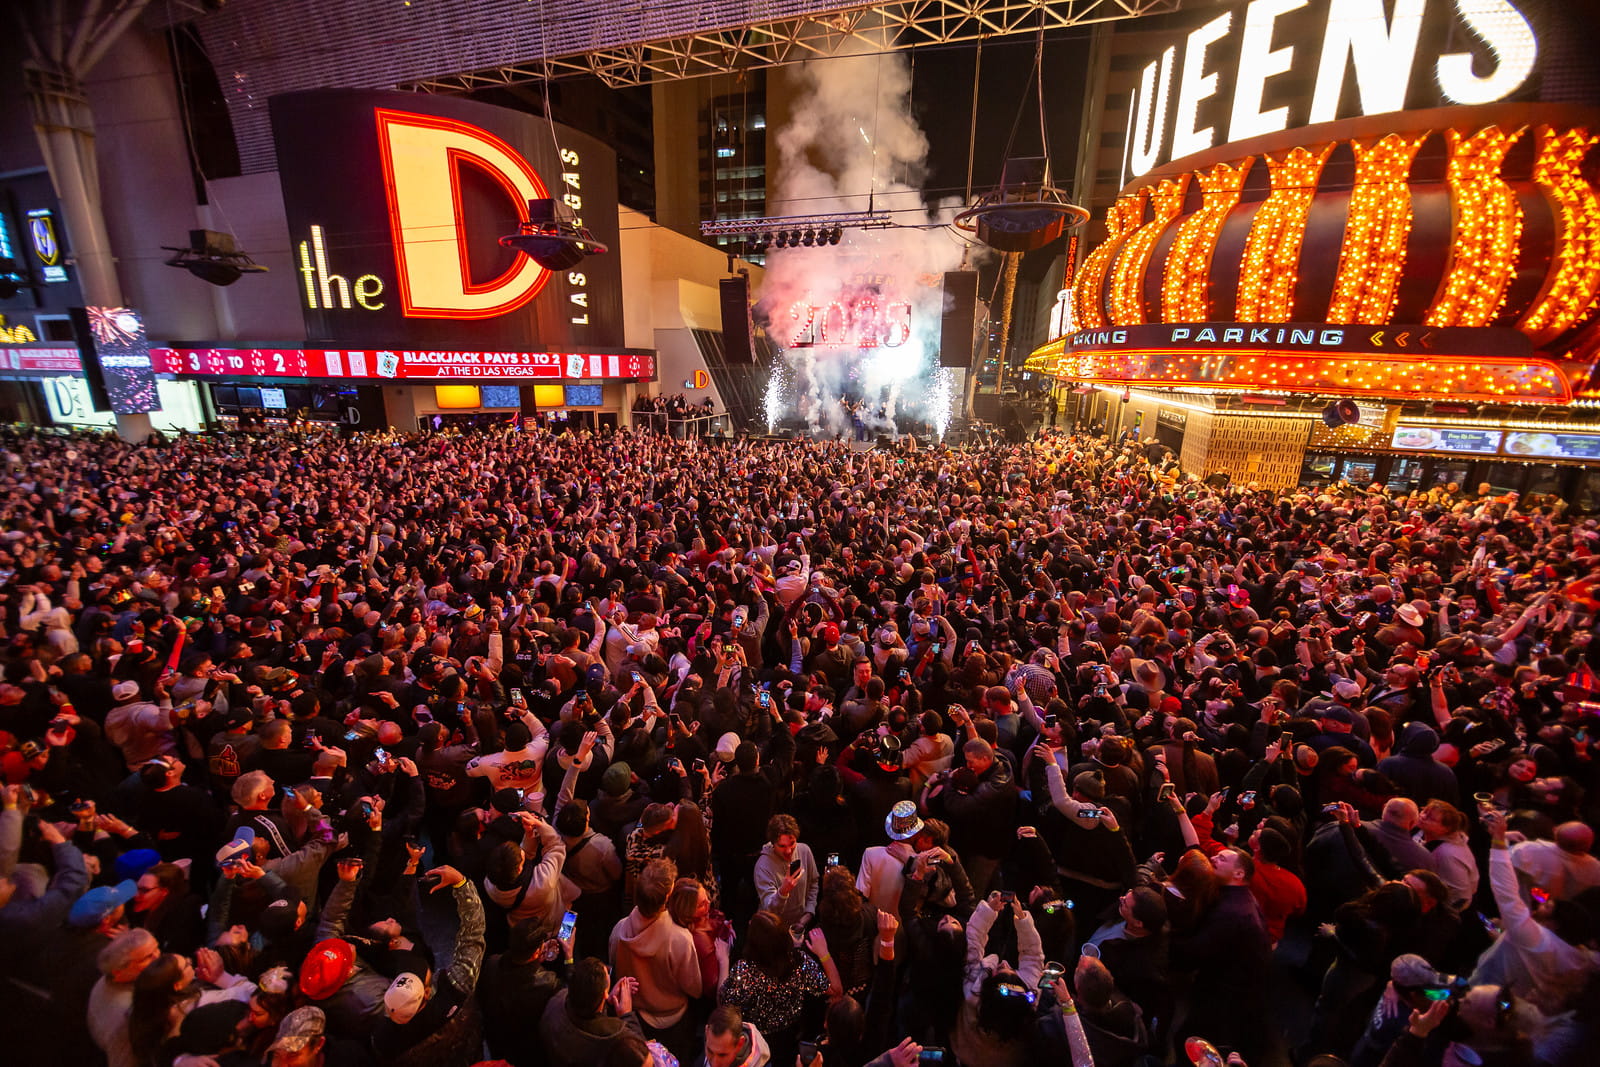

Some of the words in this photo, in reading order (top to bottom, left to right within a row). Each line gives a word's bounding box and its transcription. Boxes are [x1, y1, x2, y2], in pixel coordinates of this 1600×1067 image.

[1120, 0, 1538, 191] UEENS
[300, 225, 385, 311] the
[374, 107, 555, 320] D
[568, 271, 589, 326] LAS
[789, 300, 912, 348] 2025
[1171, 328, 1344, 346] PARKING
[188, 352, 201, 371] 3
[227, 355, 244, 369] TO
[272, 353, 286, 372] 2
[402, 351, 481, 364] BLACKJACK
[483, 352, 519, 364] PAYS
[521, 354, 530, 364] 3
[532, 354, 550, 364] TO
[552, 354, 561, 364] 2
[437, 366, 451, 375] AT
[453, 366, 471, 375] THE
[473, 366, 481, 375] D
[483, 367, 501, 375] LAS
[502, 367, 534, 376] VEGAS
[694, 369, 709, 389] D
